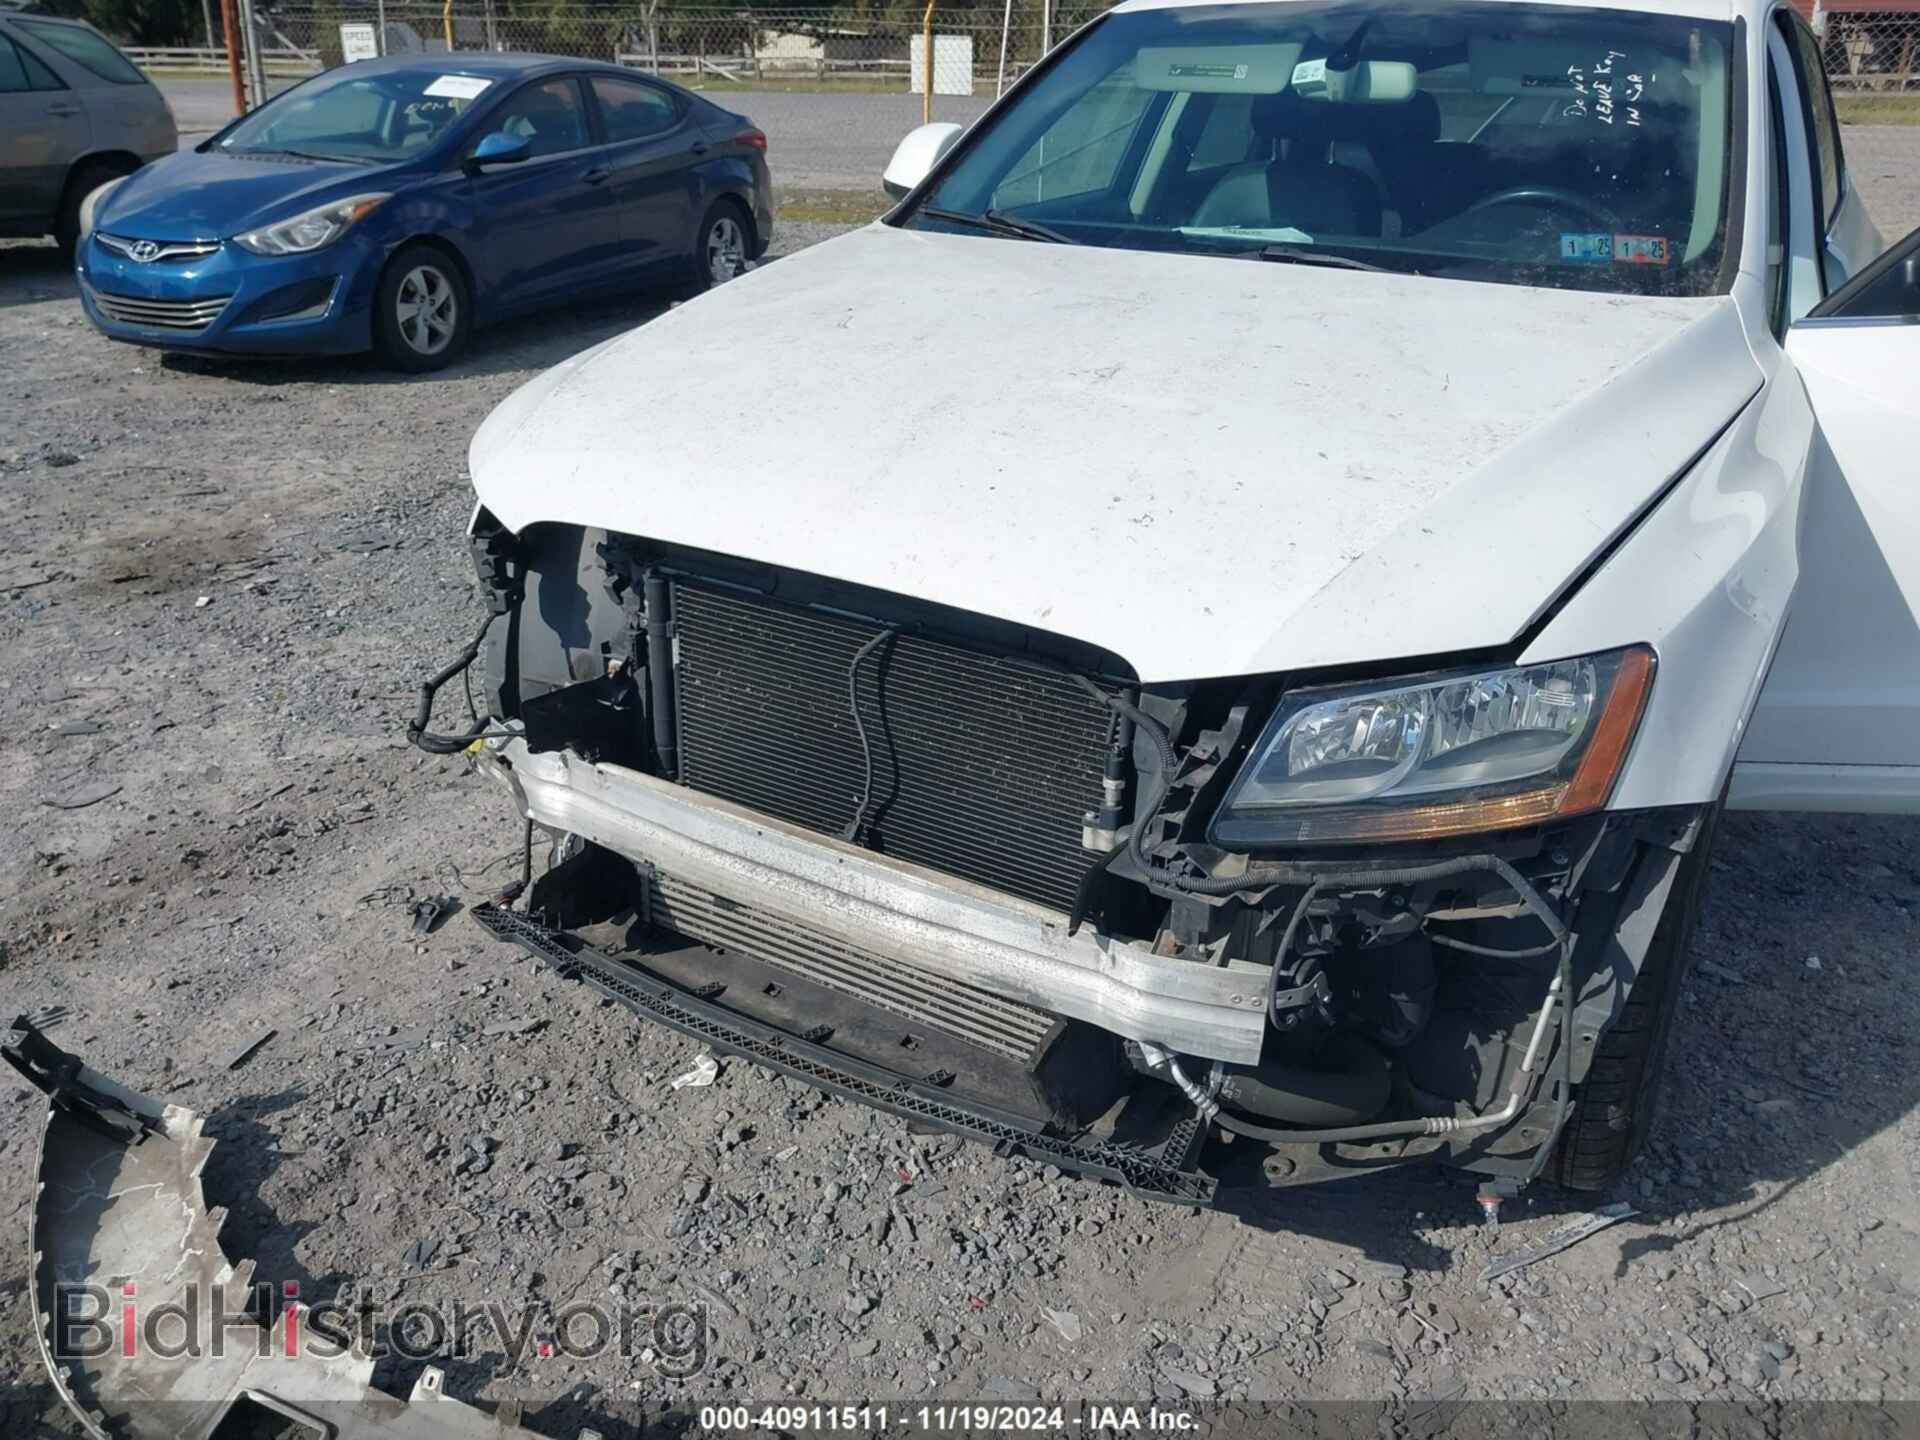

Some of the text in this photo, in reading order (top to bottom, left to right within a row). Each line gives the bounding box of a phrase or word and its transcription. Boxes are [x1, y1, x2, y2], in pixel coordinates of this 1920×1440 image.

[1592, 81, 1614, 124] LEAVE
[1626, 107, 1641, 126] IN
[1567, 238, 1609, 255] 1 25
[1651, 241, 1665, 259] 25
